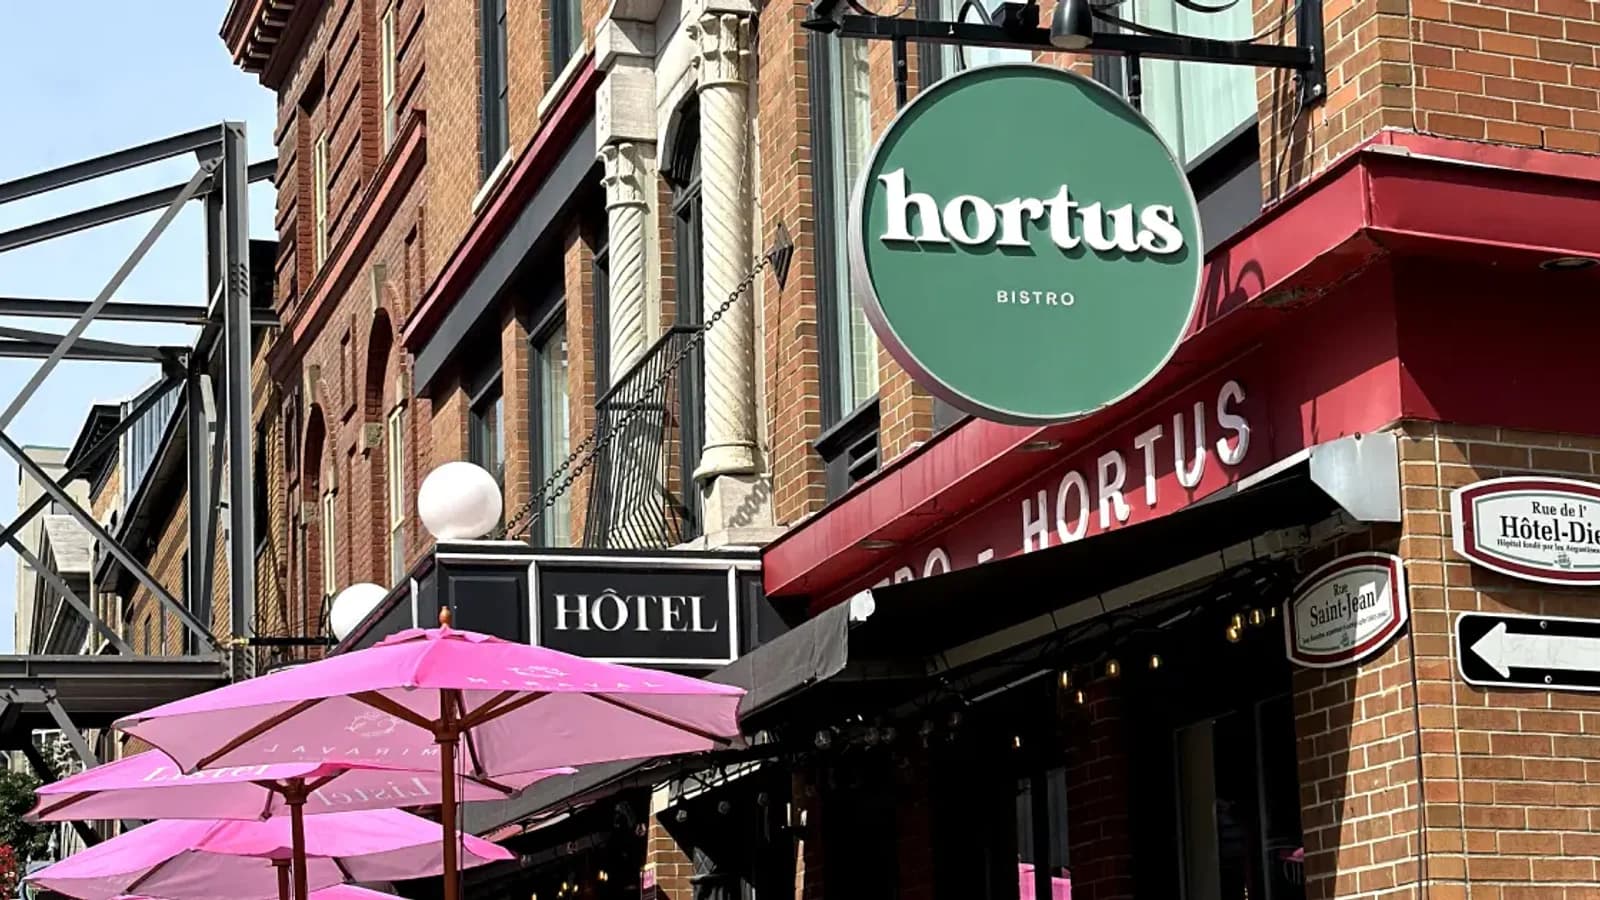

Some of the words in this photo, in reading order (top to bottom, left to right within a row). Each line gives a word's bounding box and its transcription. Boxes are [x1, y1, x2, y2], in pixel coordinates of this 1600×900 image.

[877, 167, 1185, 255] hortus
[996, 289, 1075, 307] BISTRO
[1021, 379, 1251, 554] HORTUS
[1532, 501, 1557, 516] Rue
[1560, 503, 1576, 517] de
[1333, 583, 1348, 597] Rue
[553, 587, 718, 633] HÔTEL
[1310, 591, 1376, 628] Saint-Jean
